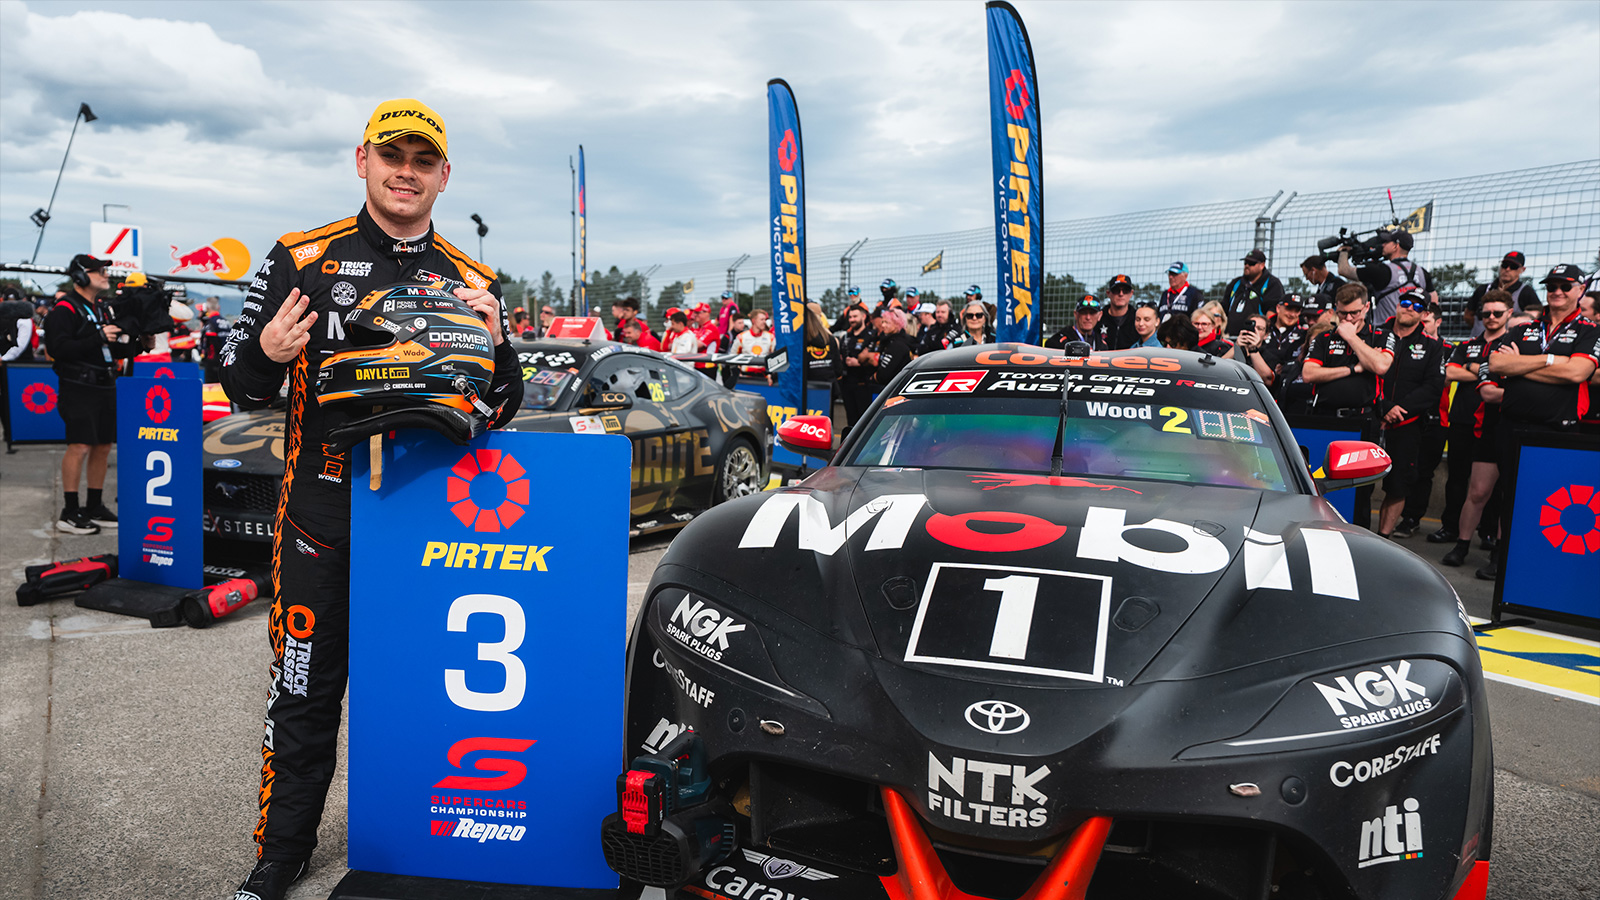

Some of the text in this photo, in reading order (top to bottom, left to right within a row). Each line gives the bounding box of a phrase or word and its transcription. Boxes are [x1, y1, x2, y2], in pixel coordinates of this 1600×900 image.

[378, 109, 443, 134] DUNLOP
[1007, 123, 1033, 331] PIRTEK
[295, 246, 322, 260] OMP
[779, 174, 804, 332] PIRTEK
[997, 175, 1014, 327] VICTORY LANE
[338, 268, 371, 277] ASSIST
[340, 261, 374, 270] TRUCK
[772, 216, 791, 335] VICTORY LANE
[465, 271, 487, 288] OMP
[407, 287, 441, 297] Mobil
[428, 332, 489, 347] DORMER
[450, 342, 475, 350] HVAC
[974, 350, 1182, 372] Coates
[355, 367, 389, 381] DAYLE
[904, 371, 983, 393] GR
[996, 372, 1250, 396] TOYOTA GAZOO Racing
[601, 392, 626, 402] 100
[648, 382, 665, 402] 26
[987, 380, 1156, 397] Australia
[1085, 401, 1192, 434] Wood 2
[138, 426, 179, 442] PIRTEK
[799, 423, 827, 439] BOC
[146, 450, 173, 507] 2
[318, 473, 343, 484] WOOD
[224, 520, 275, 537] STEEL
[421, 541, 554, 572] PIRTEK
[738, 493, 1361, 601] Mobil
[150, 553, 174, 567] Repco
[669, 592, 747, 652] NGK
[982, 574, 1041, 661] 1
[444, 593, 528, 712] 3
[666, 622, 723, 662] SPARK PLUGS
[282, 633, 298, 695] ASSIST
[292, 641, 313, 698] TRUCK
[1312, 659, 1427, 717] NGK
[1340, 697, 1432, 730] SPARK PLUGS
[928, 750, 1052, 806] NTK
[430, 795, 528, 810] SUPERCARS
[430, 805, 528, 819] CHAMPIONSHIP
[928, 795, 1048, 829] FILTERS
[452, 817, 527, 843] Repco
[1358, 797, 1424, 862] nti
